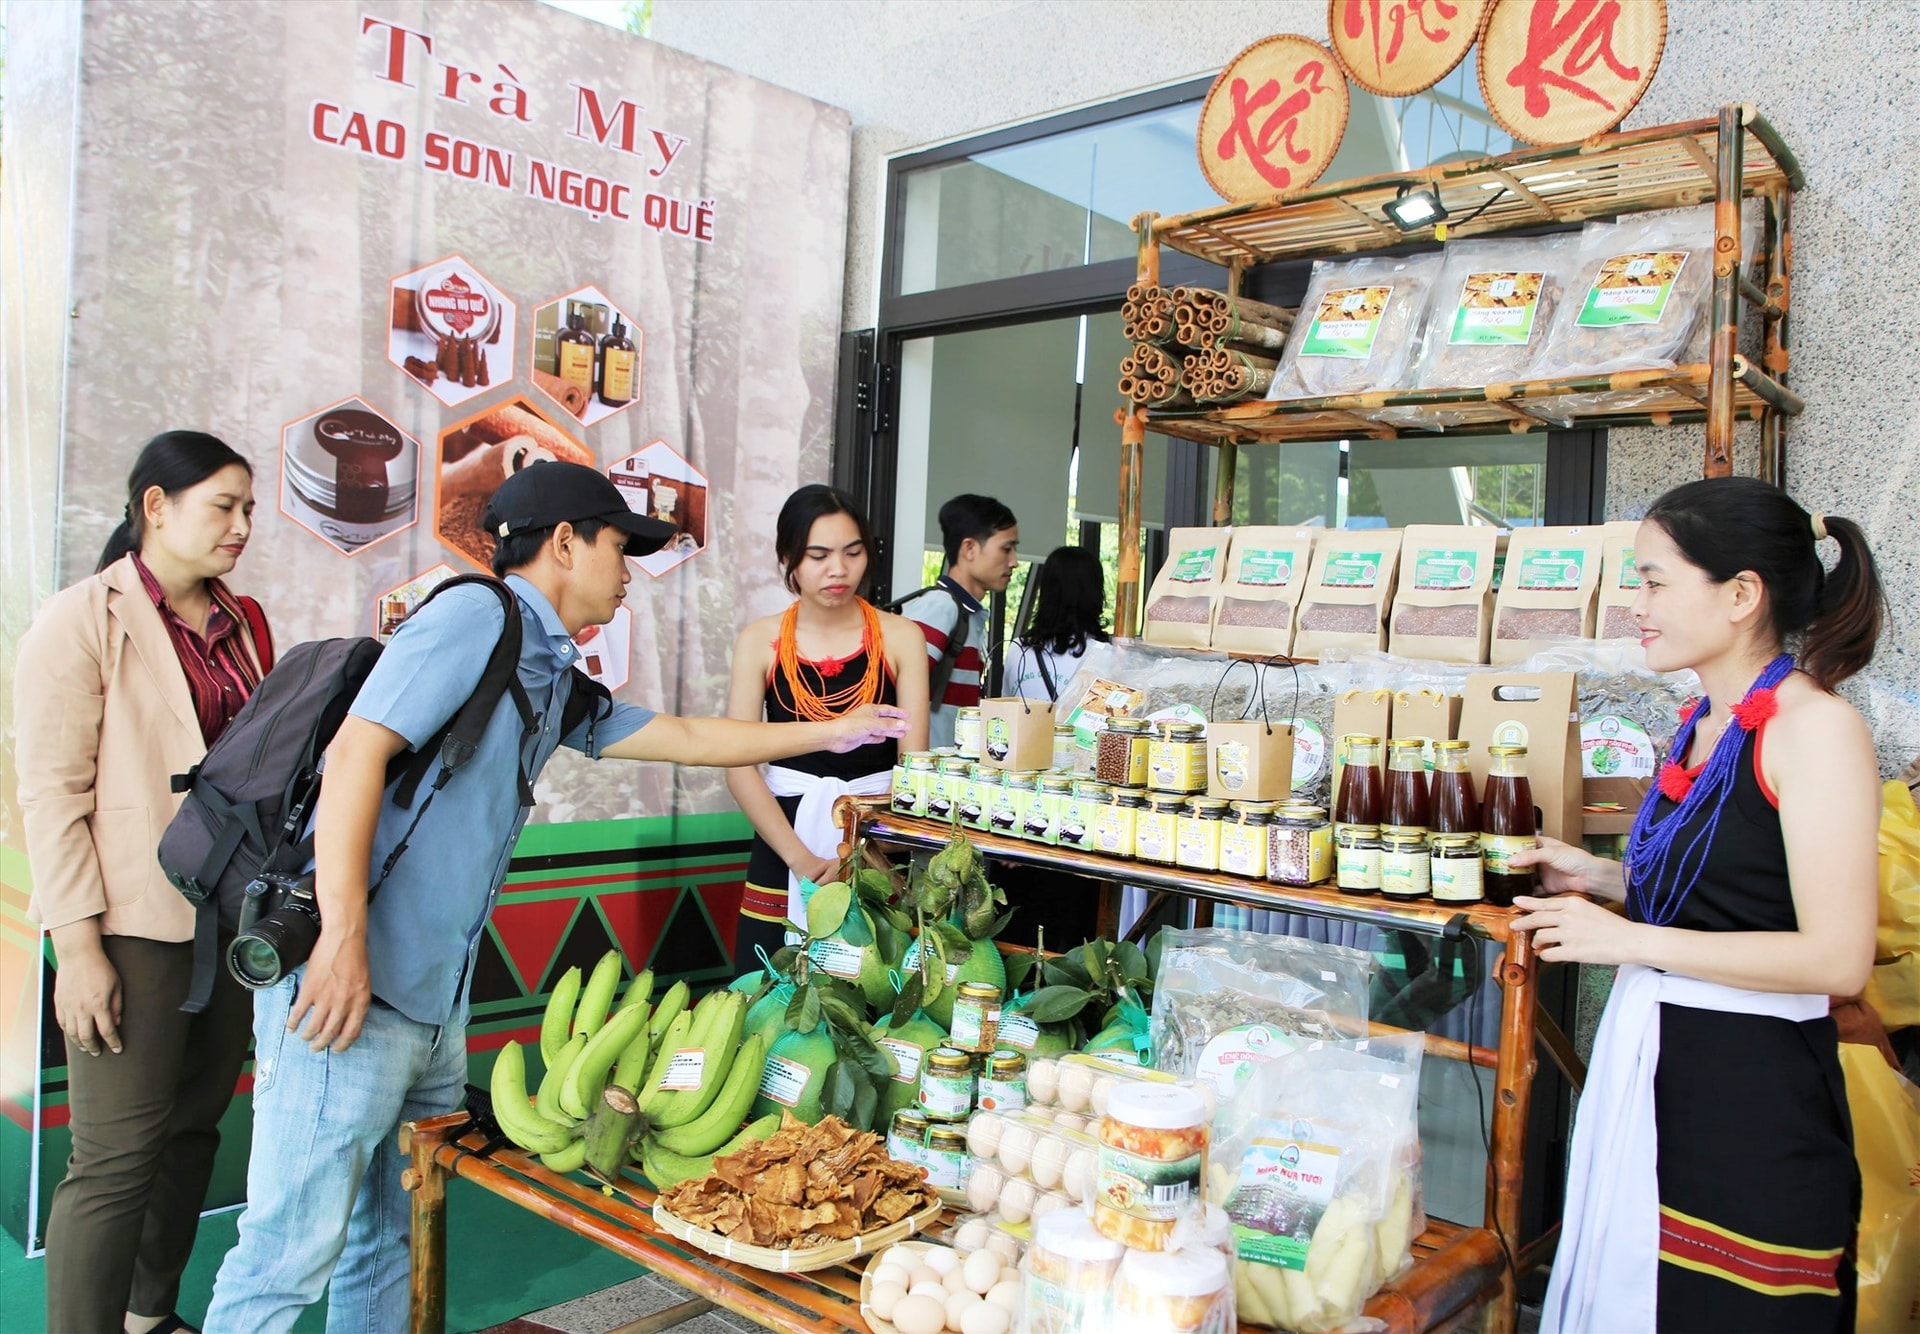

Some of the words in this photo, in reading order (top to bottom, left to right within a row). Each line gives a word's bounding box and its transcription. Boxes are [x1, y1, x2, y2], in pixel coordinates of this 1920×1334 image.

[312, 102, 405, 160] CAO
[424, 132, 513, 188] SƠN
[529, 161, 631, 220] NGỌC
[645, 198, 715, 242] QUẾ
[361, 16, 532, 122] Trà
[566, 82, 690, 178] My
